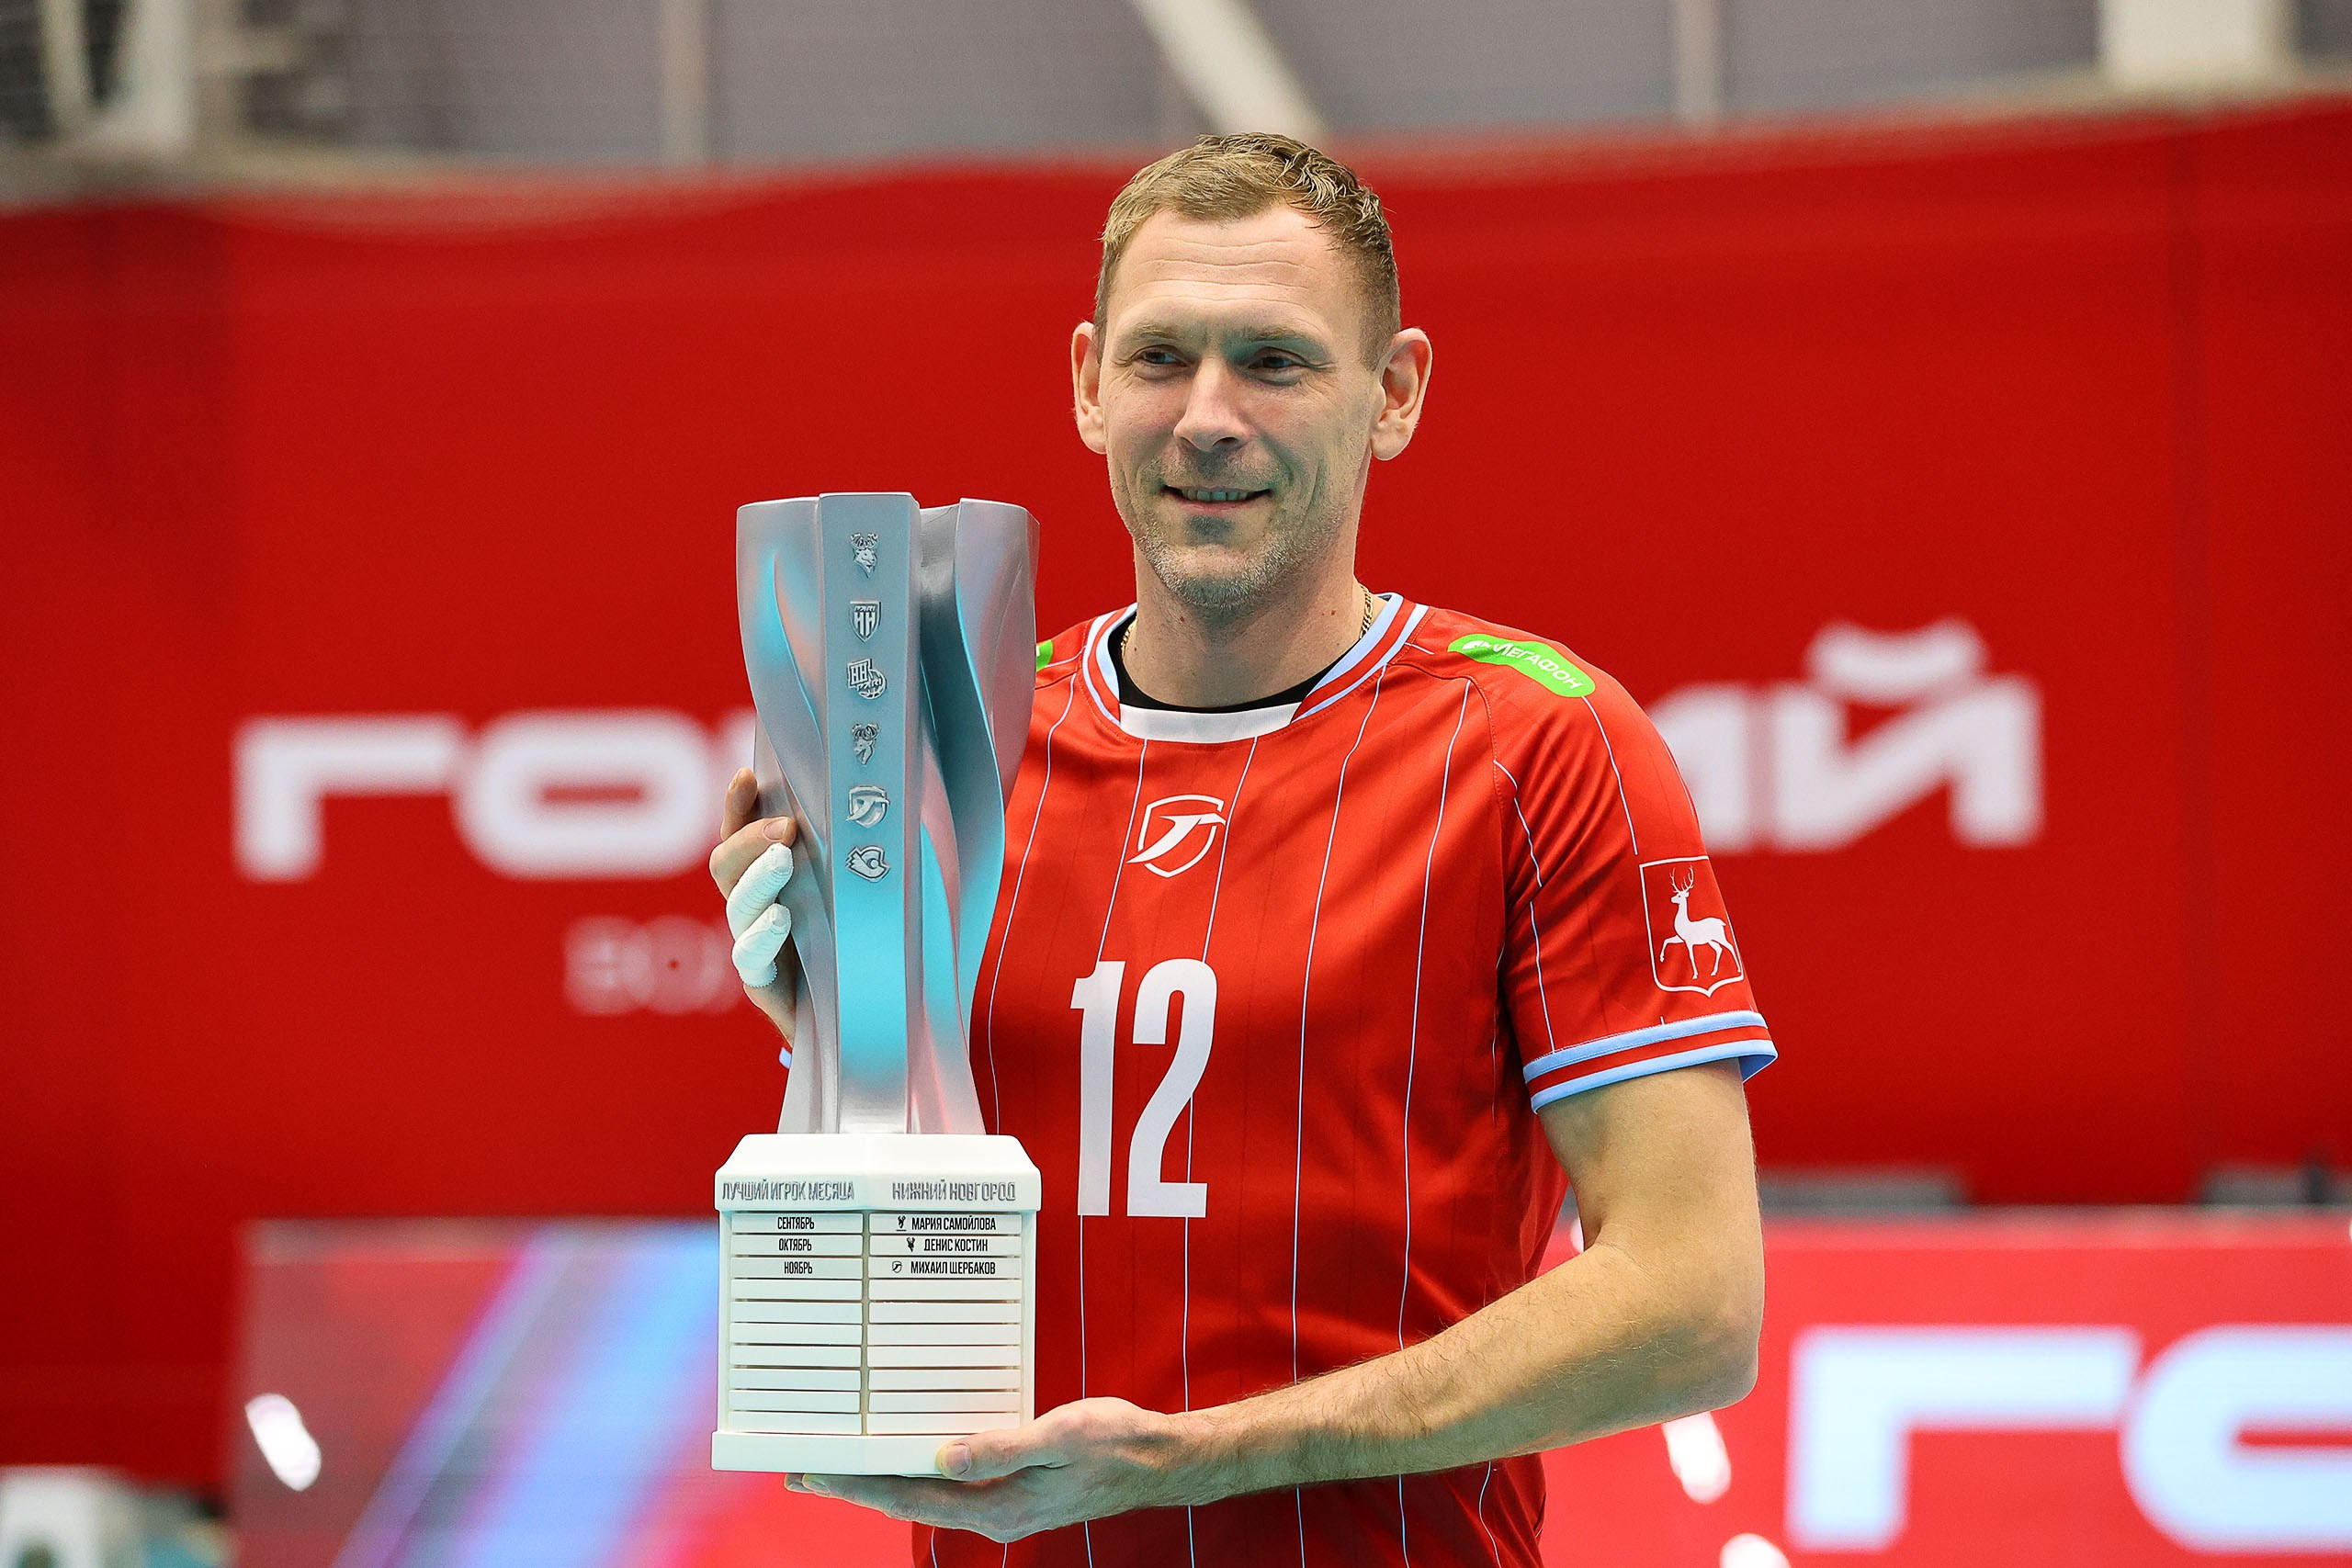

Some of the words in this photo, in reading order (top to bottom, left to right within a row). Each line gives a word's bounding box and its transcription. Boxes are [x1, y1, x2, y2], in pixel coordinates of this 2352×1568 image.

[1069, 958, 1217, 1217] 12
[722, 1179, 769, 1201] ЛУЧШИЙ
[770, 1180, 806, 1201] ИГРОК
[808, 1180, 854, 1201] МЕСЯЦА
[892, 1179, 947, 1201] НИЖНИЙ
[949, 1181, 1016, 1201] НОВГОРОД
[777, 1216, 815, 1230] СЕНТЯБРЬ
[911, 1217, 943, 1230] МАРИЯ
[943, 1214, 996, 1231] САМОЙЛОВА
[778, 1238, 812, 1251] ОКТЯБРЬ
[923, 1238, 953, 1252] ДЕНИС
[955, 1238, 989, 1252] КОСТИН
[784, 1261, 813, 1274] НОЯБРЬ
[910, 1261, 948, 1274] МИХАИЛ
[949, 1261, 996, 1275] ЩЕРБАКОВ
